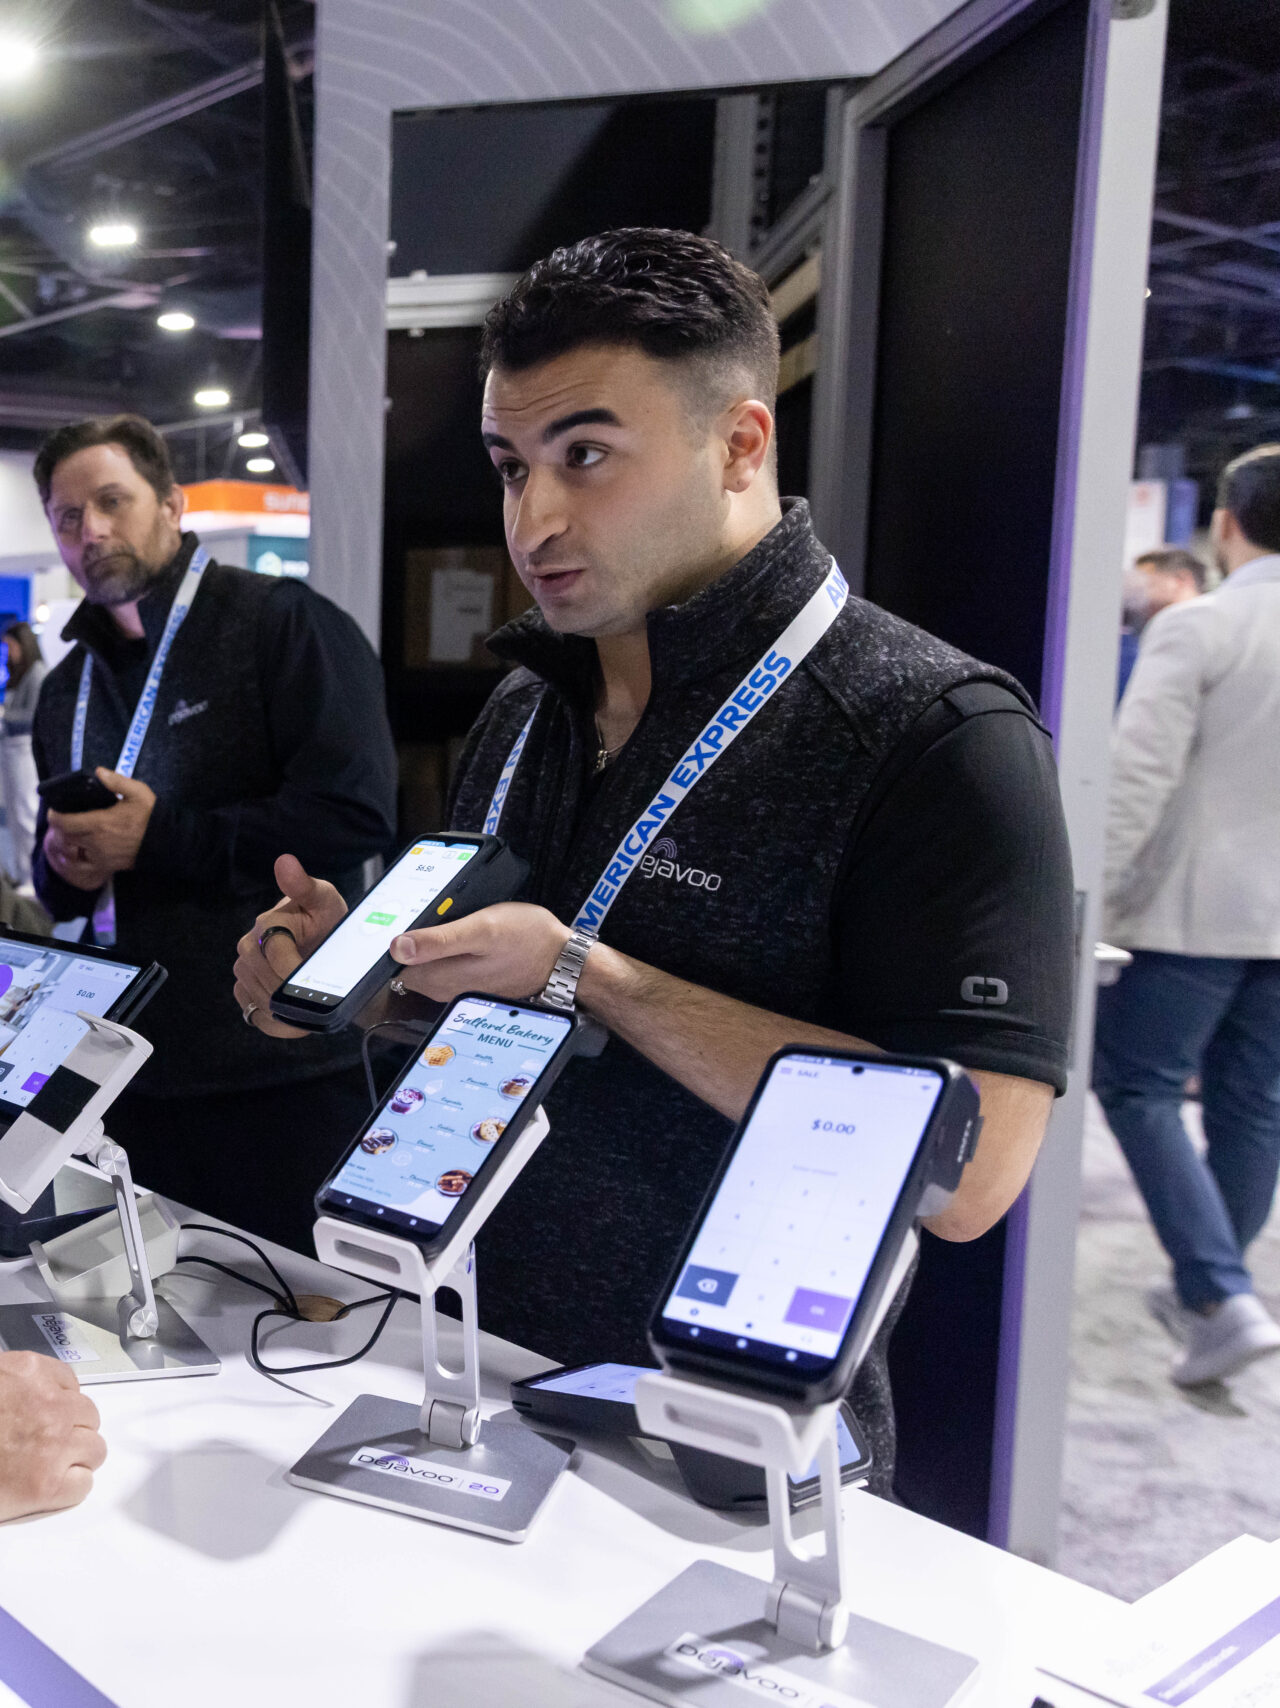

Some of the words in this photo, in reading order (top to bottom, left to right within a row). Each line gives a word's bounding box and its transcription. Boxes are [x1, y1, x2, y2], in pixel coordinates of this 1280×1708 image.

[119, 685, 158, 777] AMERICAN
[575, 793, 676, 931] MERICAN
[670, 650, 792, 789] EXPRESS
[639, 854, 722, 891] ejavoo
[453, 1012, 504, 1034] Salford
[506, 1024, 555, 1047] Bakery
[477, 1032, 514, 1049] MENU
[357, 1453, 453, 1484] Dejavoo
